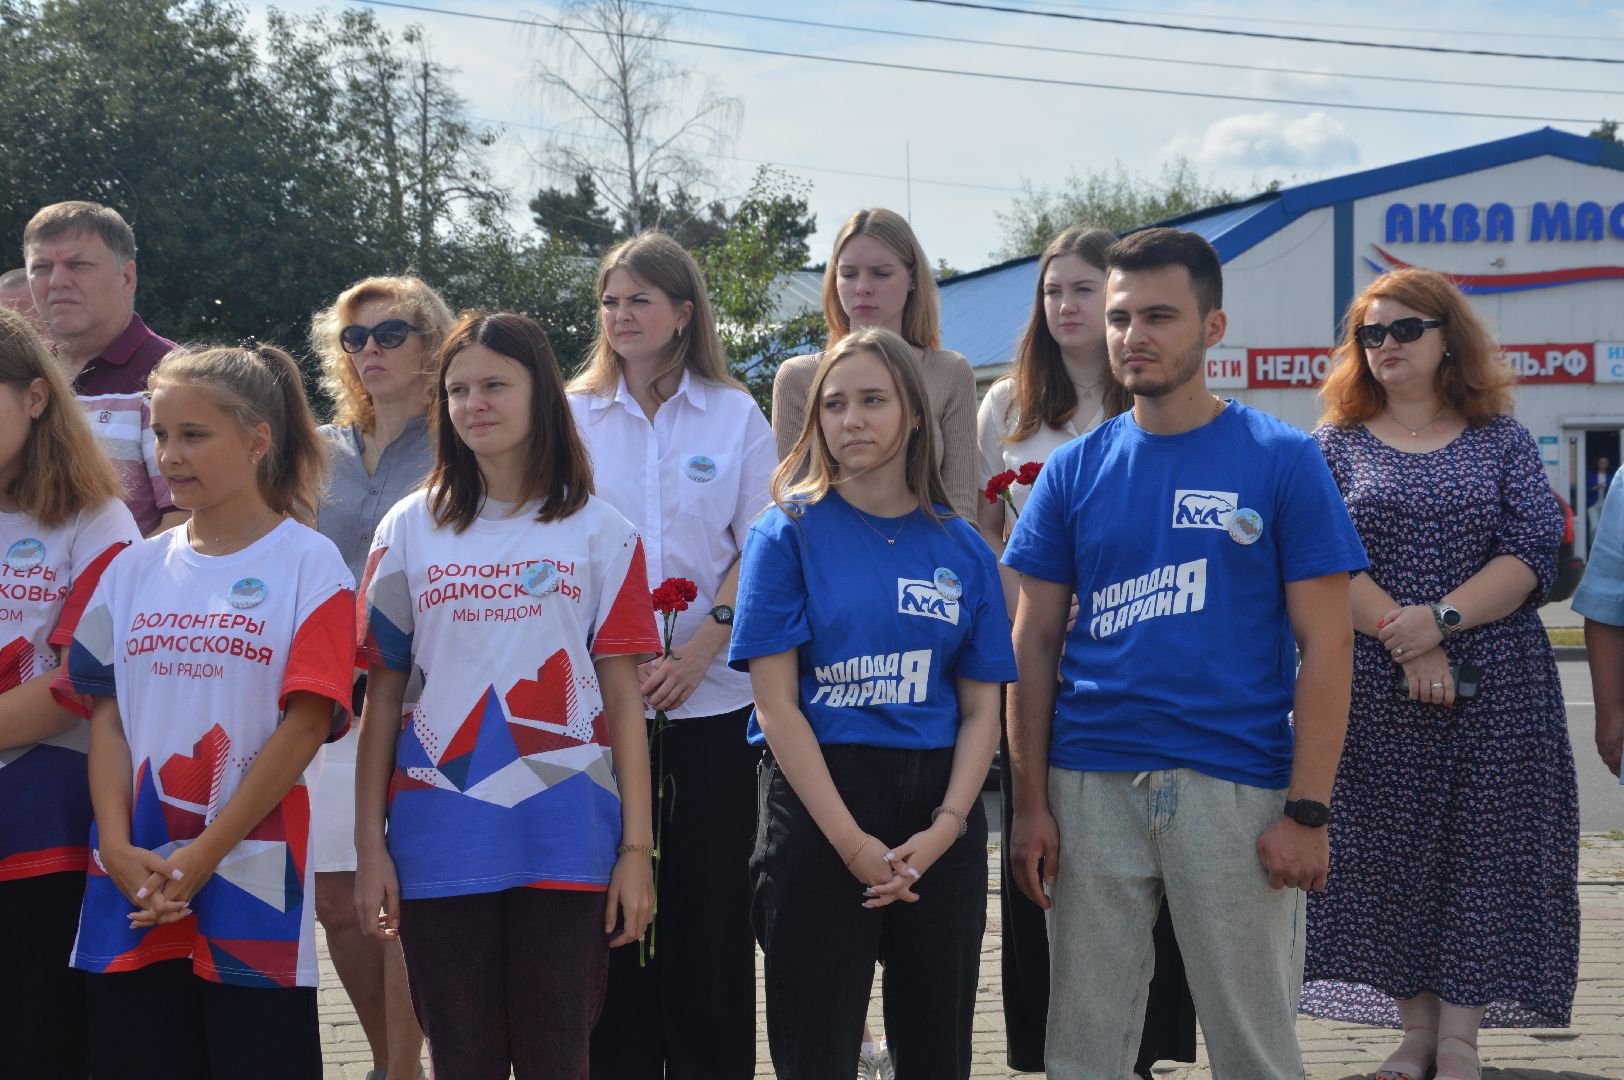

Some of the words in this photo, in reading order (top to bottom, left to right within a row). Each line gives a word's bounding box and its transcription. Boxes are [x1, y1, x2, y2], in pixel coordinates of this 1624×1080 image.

[1385, 203, 1514, 243] АКВА
[1207, 360, 1242, 378] СТИ
[428, 559, 575, 584] ВОЛОНТЫ
[419, 578, 582, 613] ПОДМОСКЬЯ
[131, 612, 266, 636] ВОЛОНТЕРЫ
[452, 608, 480, 622] МЫ
[484, 603, 542, 622] РЯДОМ
[124, 634, 273, 666] ОДМОСКОВЬЯ
[177, 662, 224, 679] РЯДОМ
